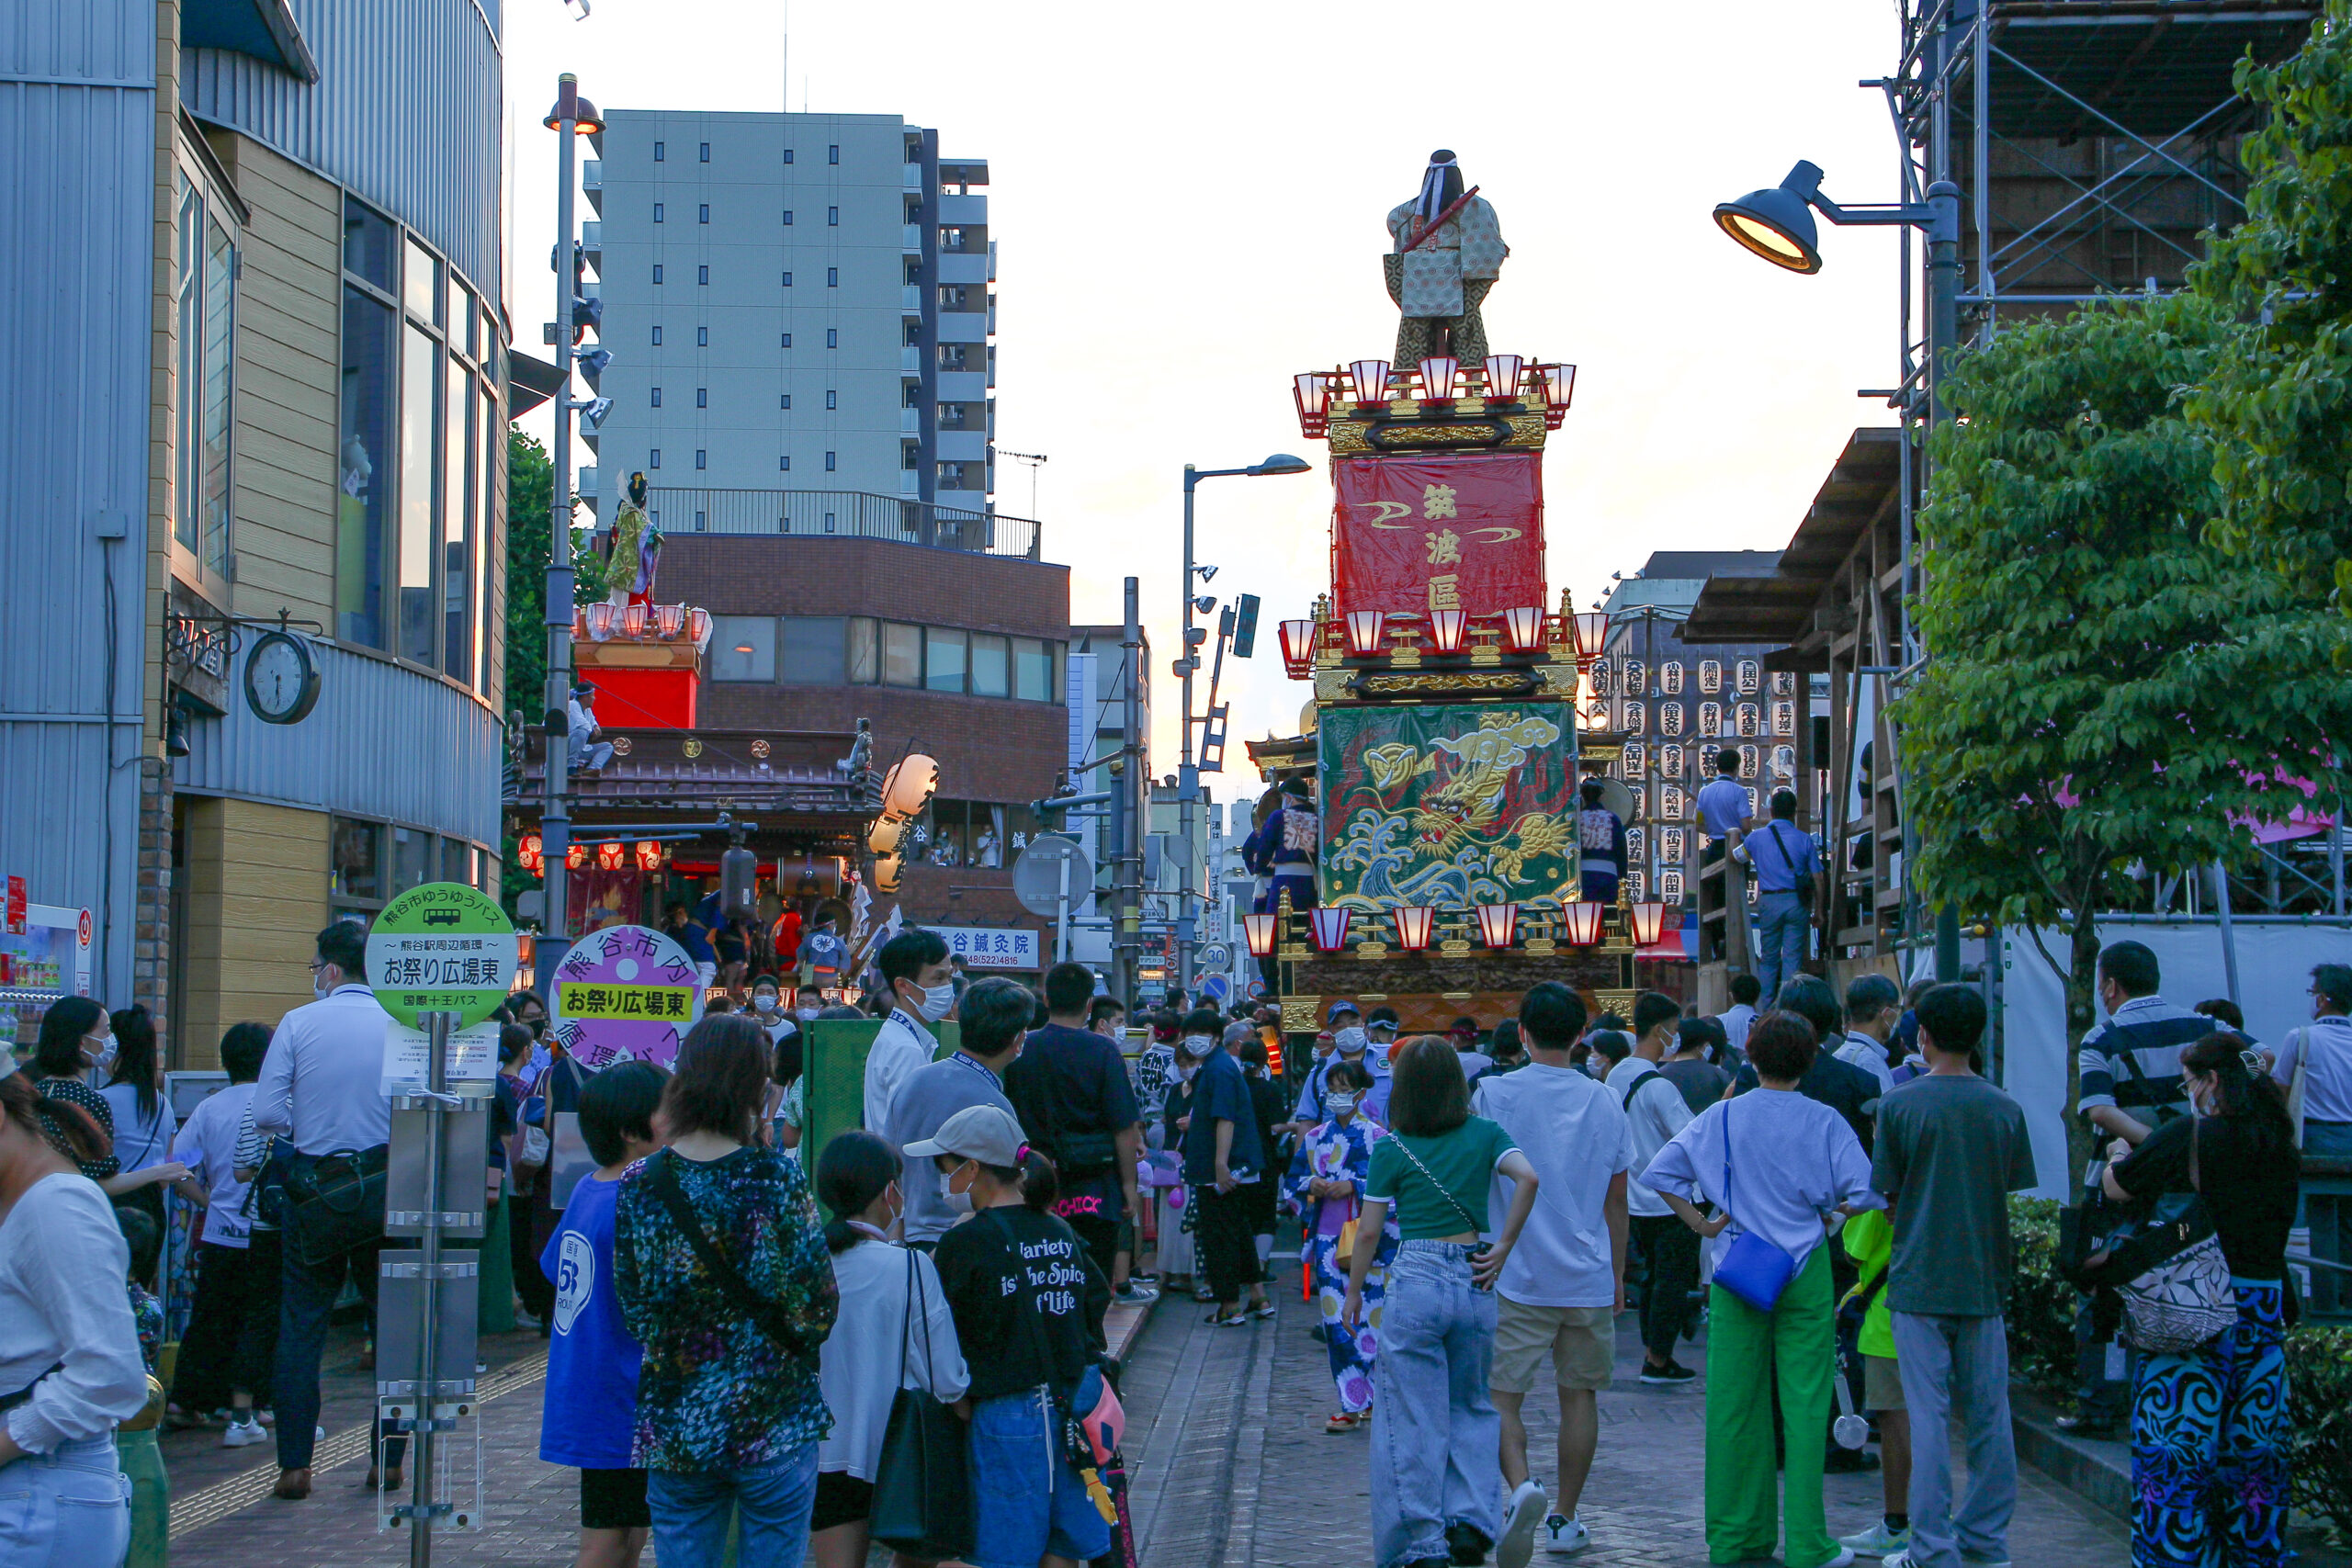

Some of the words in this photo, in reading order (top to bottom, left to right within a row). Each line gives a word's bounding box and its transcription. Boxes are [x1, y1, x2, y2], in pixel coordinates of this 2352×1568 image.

[384, 889, 501, 926] 熊谷市ゆうゆうバス
[939, 931, 1029, 954] 谷鍼灸院
[564, 932, 689, 983] 熊谷市内
[964, 955, 1018, 965] 48(522)4816
[1207, 950, 1225, 964] 30
[384, 957, 500, 985] お祭り広場東
[403, 995, 478, 1007] 国際十王バス
[567, 988, 686, 1016] お祭り広場東
[1047, 1262, 1086, 1286] Spice
[1044, 1291, 1076, 1315] Life
